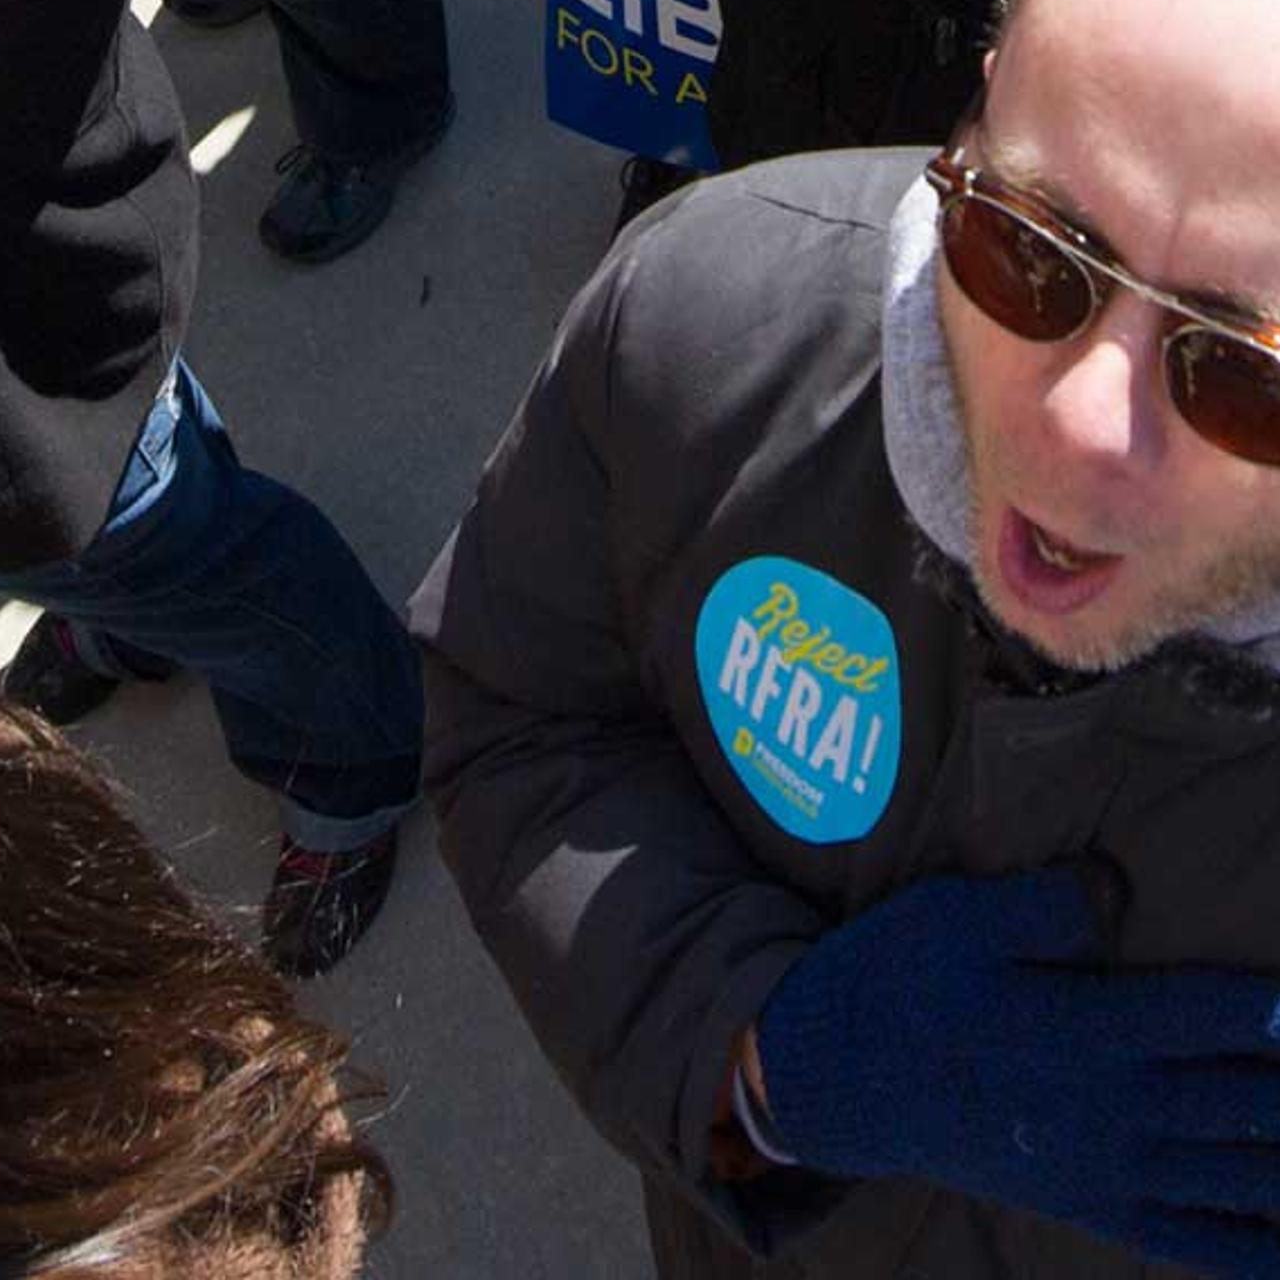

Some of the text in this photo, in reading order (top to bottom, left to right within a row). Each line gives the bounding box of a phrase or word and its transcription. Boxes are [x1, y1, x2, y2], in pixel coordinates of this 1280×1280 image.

[557, 6, 659, 96] FOR
[752, 582, 889, 693] Reject
[718, 614, 883, 795] RFRA!
